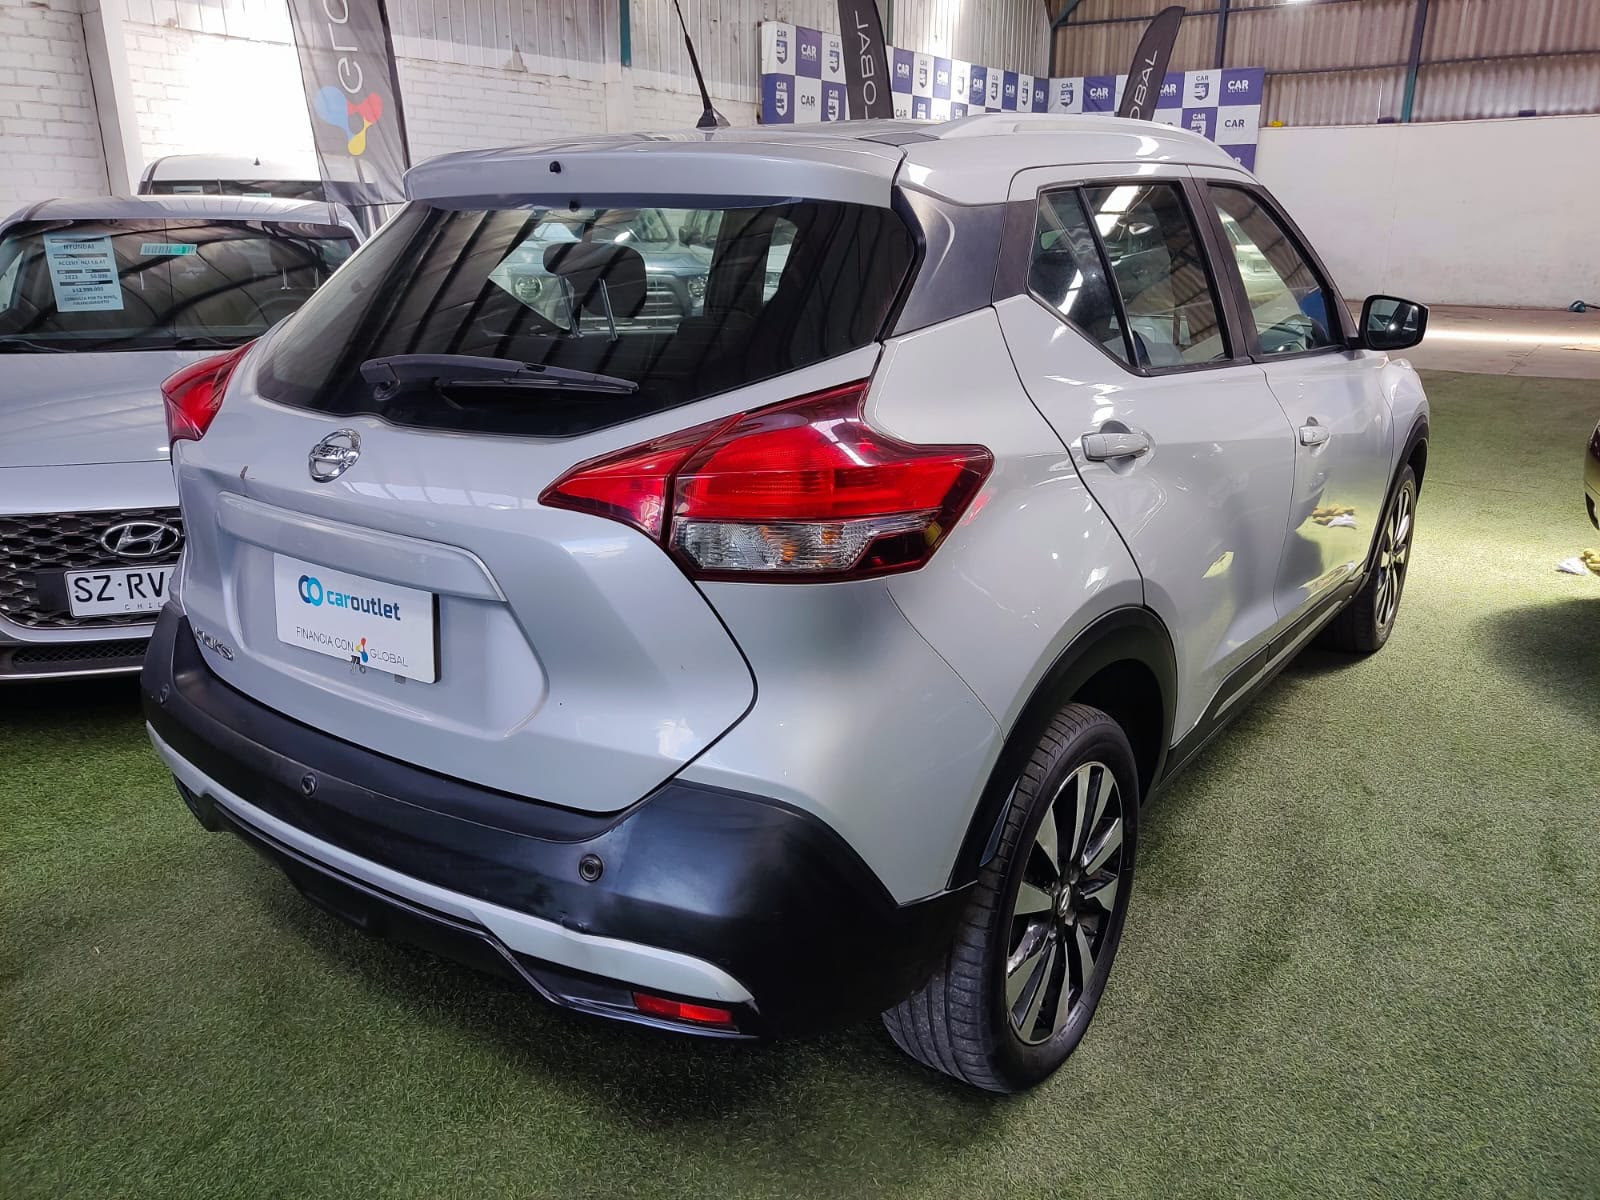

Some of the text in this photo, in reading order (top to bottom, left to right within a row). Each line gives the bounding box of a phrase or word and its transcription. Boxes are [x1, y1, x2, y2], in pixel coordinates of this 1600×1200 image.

[801, 43, 817, 58] CAR
[1228, 80, 1249, 90] CAR
[1089, 87, 1109, 97] CAR
[800, 95, 816, 106] CAR
[1192, 113, 1206, 121] CAR
[1224, 119, 1245, 128] CAR
[124, 601, 164, 610] CHIL
[326, 590, 401, 621] caroutlet
[296, 626, 354, 652] FINANCIA CON
[370, 648, 409, 667] GLOBAL
